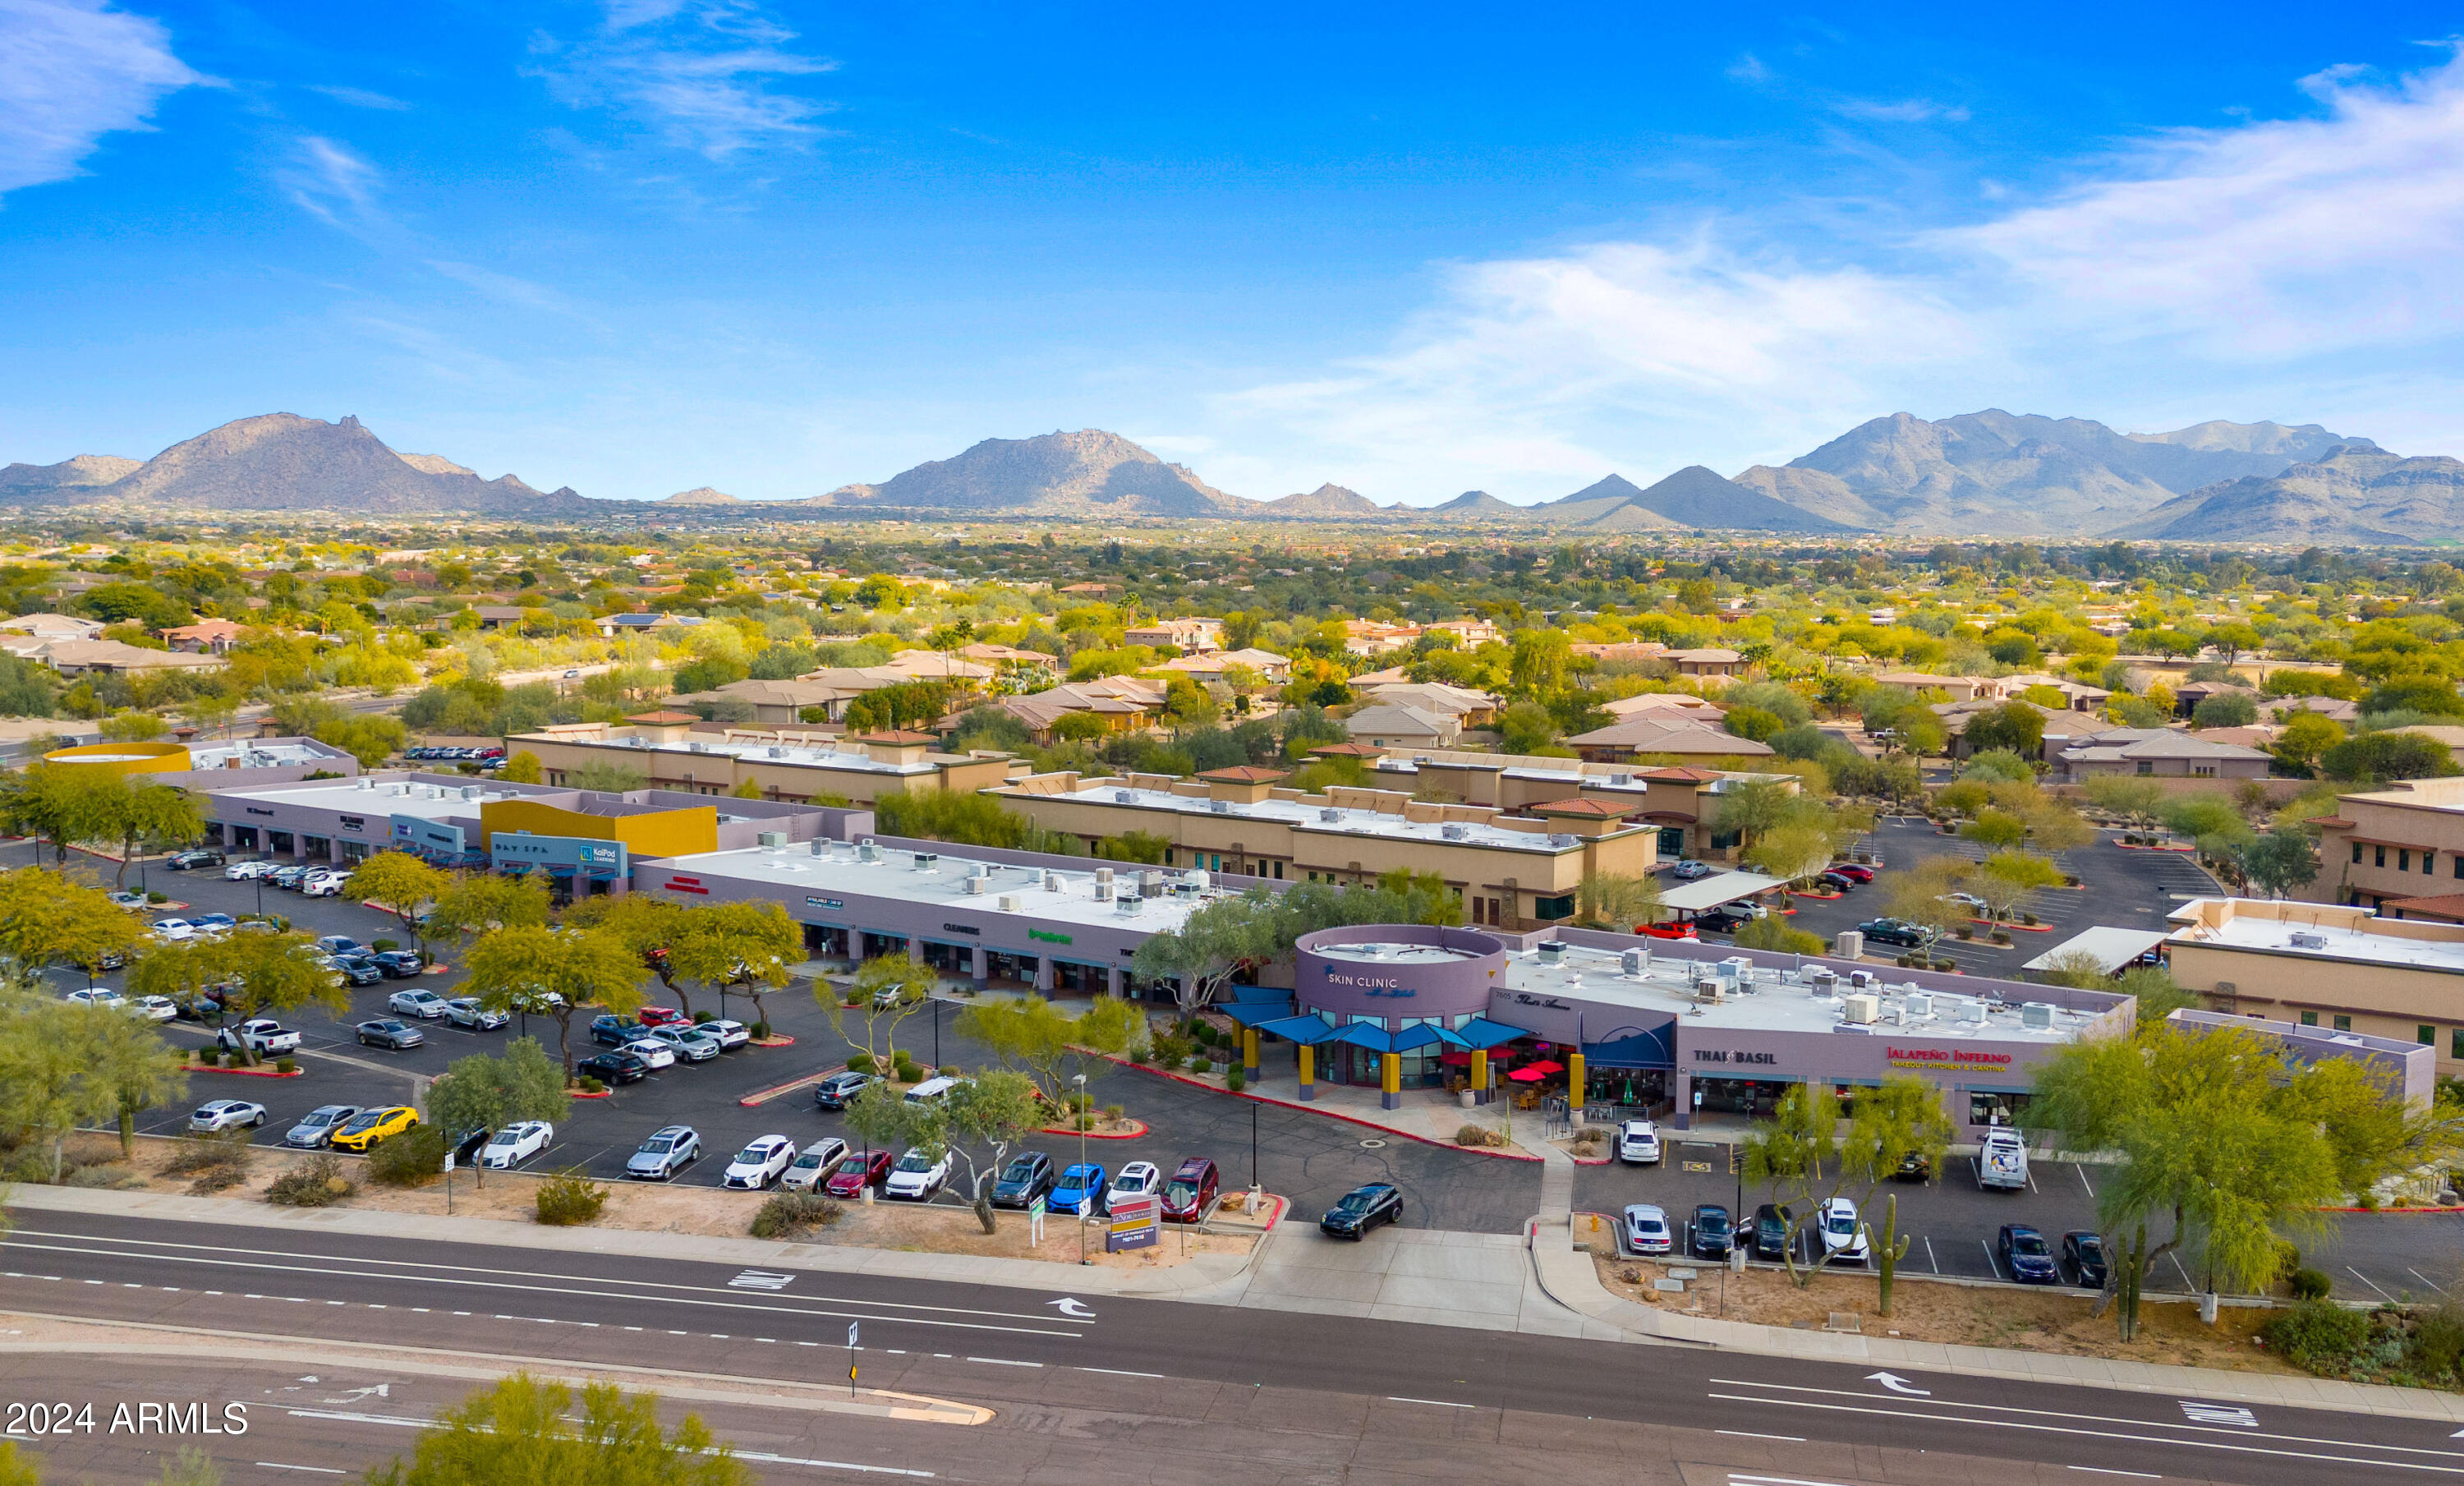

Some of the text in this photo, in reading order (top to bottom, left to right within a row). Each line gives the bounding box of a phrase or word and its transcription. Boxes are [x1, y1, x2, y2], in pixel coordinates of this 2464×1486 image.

[495, 844, 517, 852] DAY
[944, 922, 980, 936] CLEANERS
[1328, 973, 1398, 988] SKIN CLINIC
[1694, 1050, 1777, 1065] THAI BASIL
[1953, 1049, 2012, 1064] INFERNO
[1892, 1060, 1925, 1069] TAKEOUT
[1928, 1062, 1961, 1070] KITCHEN
[1972, 1064, 2007, 1073] CANTINA
